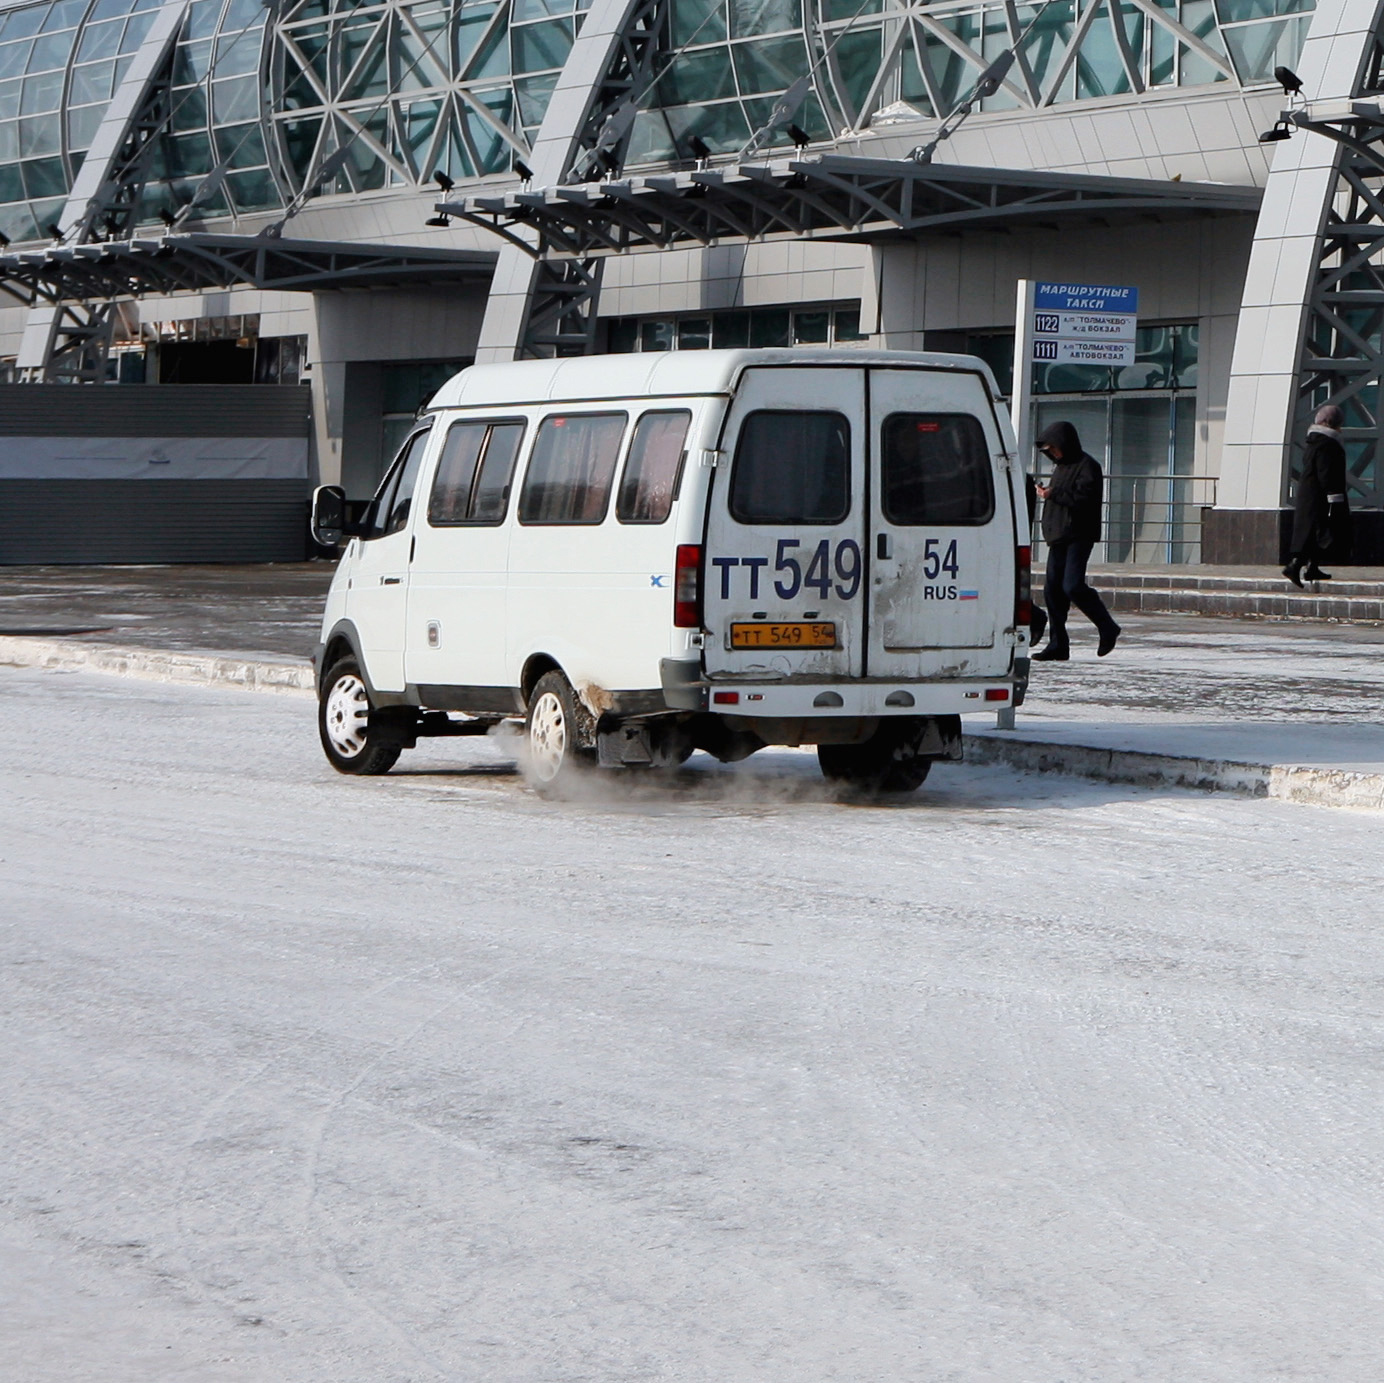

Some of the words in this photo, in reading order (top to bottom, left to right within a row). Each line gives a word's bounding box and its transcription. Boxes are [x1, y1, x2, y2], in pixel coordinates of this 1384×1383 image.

[1040, 285, 1130, 298] МАРШРУТНЫЕ
[1066, 298, 1105, 309] ТАКСИ
[1036, 316, 1058, 331] 1122
[1088, 325, 1121, 333] ВОКЗАЛ
[1034, 342, 1056, 358] 1111
[923, 538, 960, 580] 54
[924, 586, 958, 600] RUS
